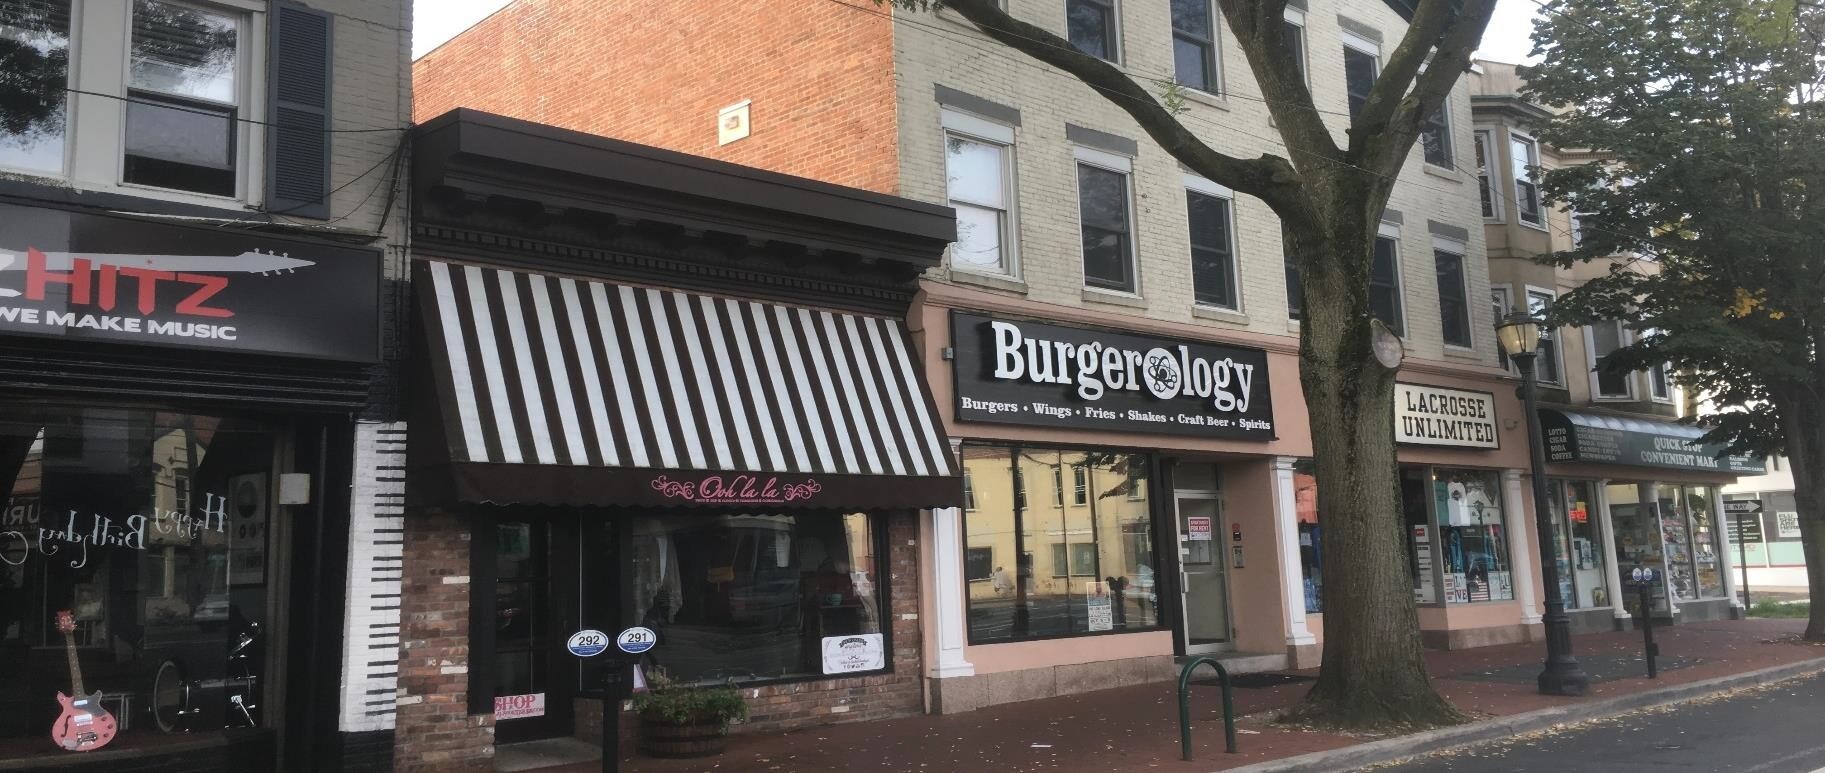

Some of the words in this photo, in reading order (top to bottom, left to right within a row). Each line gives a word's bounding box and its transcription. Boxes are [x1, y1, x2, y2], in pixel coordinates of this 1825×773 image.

[25, 246, 235, 318] HITZ
[0, 306, 39, 324] WE
[46, 310, 141, 333] MAKE
[147, 320, 237, 341] MUSIC
[961, 397, 1018, 412] Burgers
[1032, 403, 1072, 418] Wings
[1085, 407, 1116, 420] Fries
[1128, 410, 1166, 423] Shakes
[1177, 414, 1204, 426] Craft
[1206, 416, 1229, 427] Beer
[1239, 418, 1271, 430] Spirits
[1406, 391, 1486, 418] LACROSSE
[1402, 416, 1493, 443] UNLIMITED
[1654, 436, 1681, 451] QUICK
[1641, 450, 1694, 466] CONVENIENT
[700, 475, 747, 498] Ooh
[740, 477, 759, 498] la
[761, 477, 780, 498] la
[579, 635, 600, 646] 292
[628, 633, 647, 643] 291
